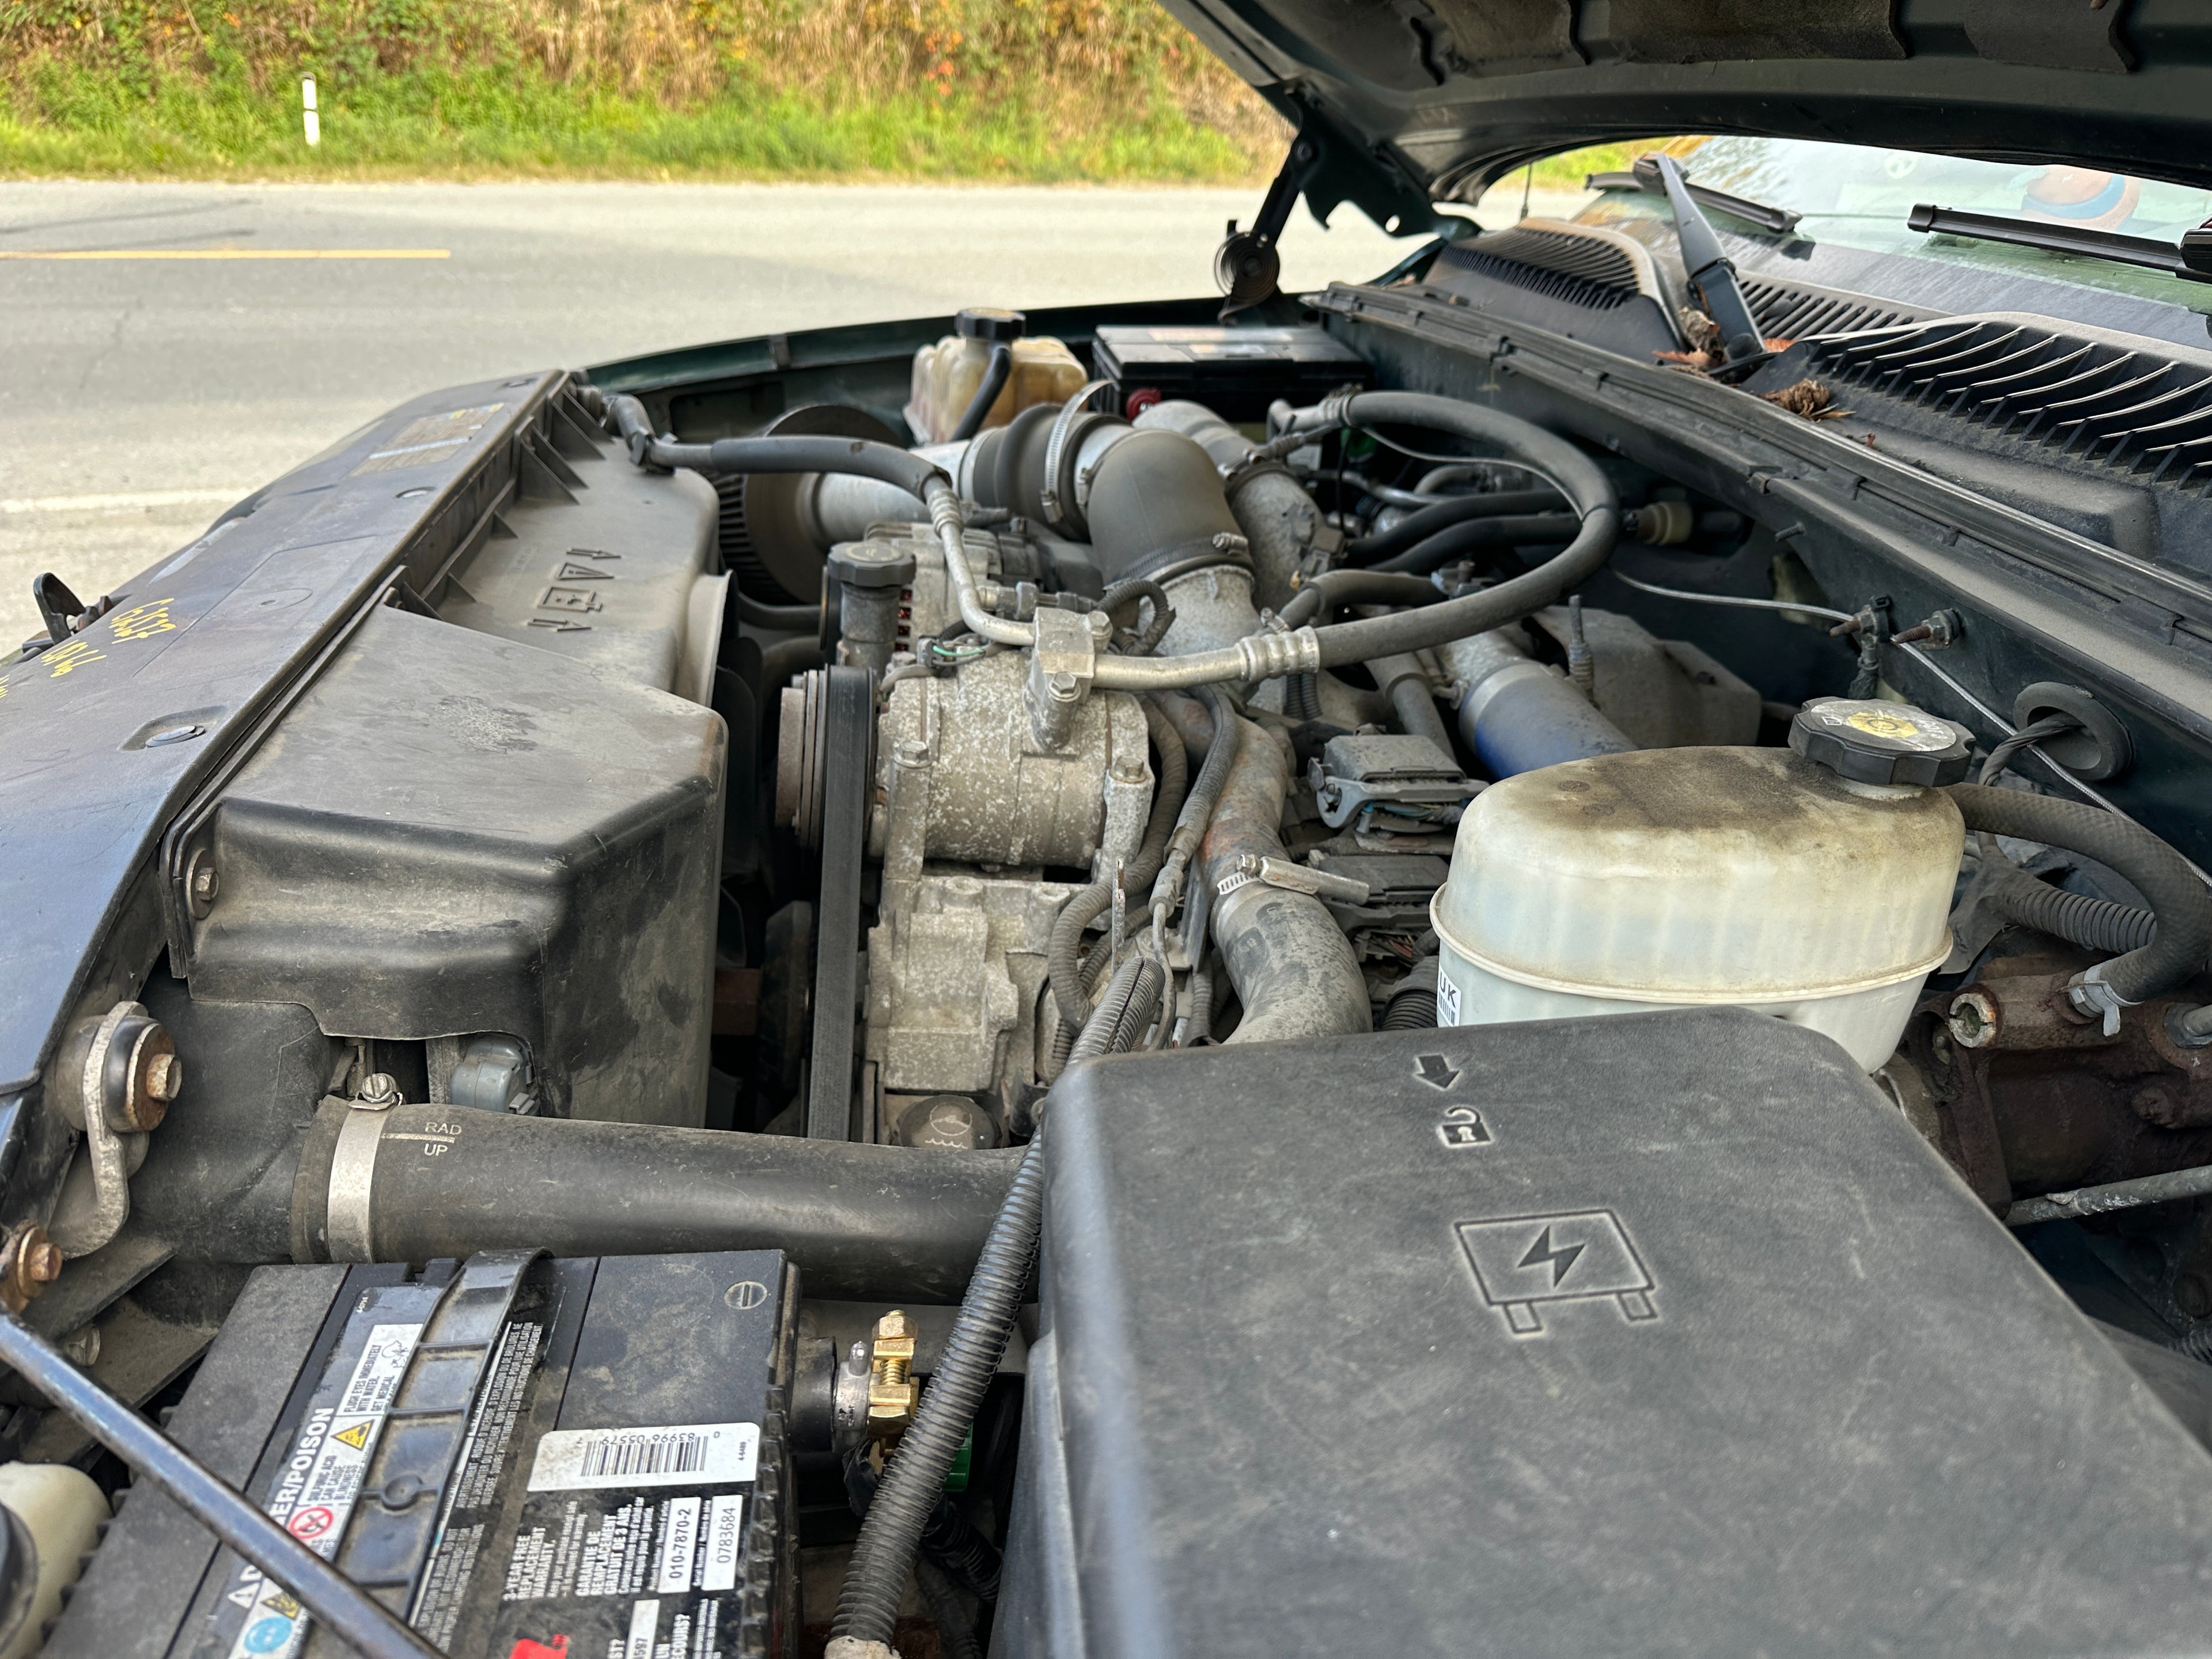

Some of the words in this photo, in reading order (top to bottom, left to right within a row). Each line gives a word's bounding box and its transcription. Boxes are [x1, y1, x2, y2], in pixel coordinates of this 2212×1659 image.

[1439, 971, 1456, 1008] UK
[425, 1121, 462, 1135] RAD
[424, 1143, 448, 1157] UP
[359, 1344, 382, 1378] IMMEDIATELY
[353, 1381, 366, 1393] EYES
[377, 1375, 395, 1399] MEDICAL
[357, 1398, 372, 1411] WITH
[372, 1402, 384, 1411] GET
[601, 1434, 645, 1445] 05579
[652, 1432, 695, 1445] 83996
[322, 1455, 337, 1469] ACID
[328, 1465, 346, 1486] CAUSE
[238, 1407, 335, 1581] DER/POISON
[321, 1488, 336, 1501] CAN
[636, 1497, 644, 1506] car
[567, 1501, 577, 1513] safe
[618, 1504, 632, 1525] ANS.
[563, 1514, 574, 1535] receipt
[631, 1507, 642, 1528] d'achat
[643, 1506, 654, 1532] garantie.
[446, 1528, 459, 1540] NOT
[657, 1522, 666, 1542] Numéro
[699, 1521, 709, 1541] Numéro
[717, 1507, 736, 1563] 0783684
[556, 1536, 570, 1563] purchase
[566, 1551, 578, 1577] required
[575, 1512, 588, 1539] warranty.
[613, 1537, 626, 1549] DE
[627, 1544, 636, 1559] votre
[640, 1540, 649, 1554] pour
[668, 1508, 691, 1578] 010-7870-2
[518, 1527, 546, 1599] REPLACEMENT
[575, 1546, 597, 1596] GARANTIE
[586, 1531, 601, 1544] DE
[591, 1514, 616, 1594] REMPLACEMENT
[654, 1547, 663, 1567] Number
[696, 1547, 705, 1567] Number
[503, 1562, 522, 1600] 3-YEAR
[513, 1535, 531, 1559] FREE
[533, 1540, 556, 1597] WARRANTY.
[555, 1565, 563, 1578] your
[604, 1552, 623, 1594] GRATUIT
[636, 1555, 646, 1574] requis
[619, 1560, 634, 1593] Conservez
[633, 1575, 643, 1586] est
[650, 1569, 659, 1589] Product
[693, 1569, 703, 1586] Serial
[548, 1580, 562, 1597] Keep
